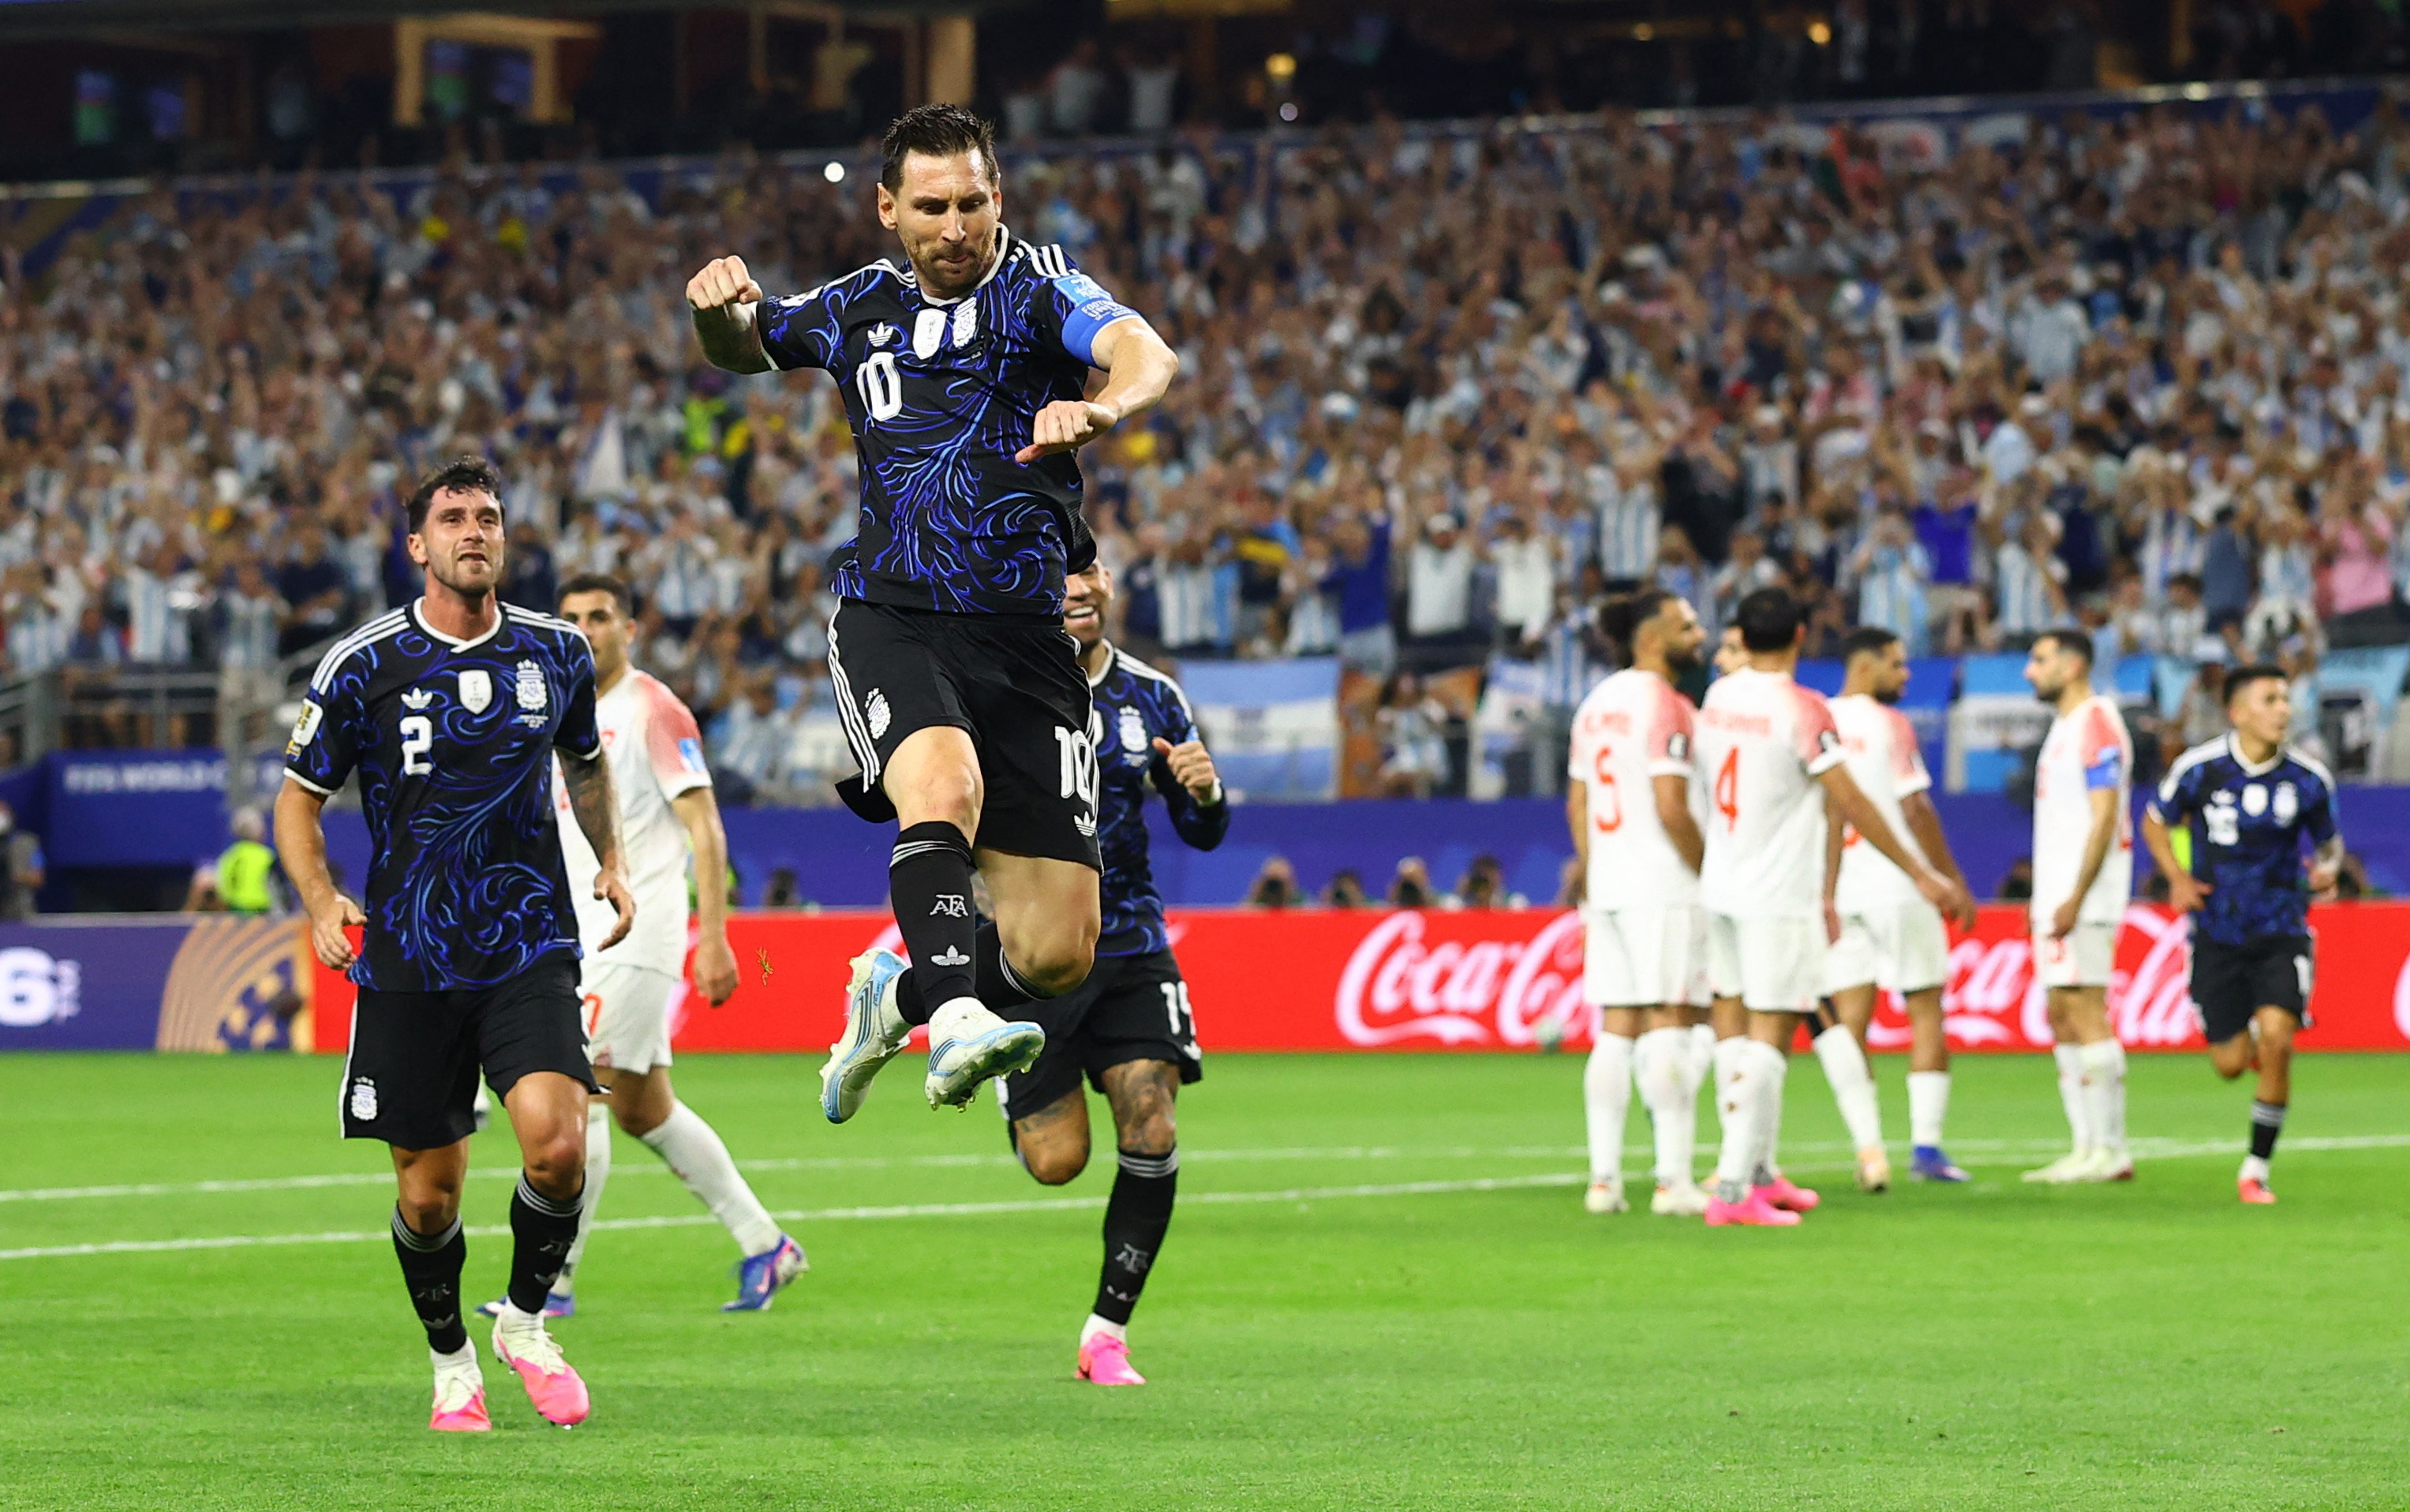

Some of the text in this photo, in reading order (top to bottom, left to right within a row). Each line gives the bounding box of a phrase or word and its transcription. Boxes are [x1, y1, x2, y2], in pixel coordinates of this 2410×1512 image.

[856, 352, 902, 428] 10
[400, 715, 433, 777] 2
[1054, 725, 1095, 805] 10
[1595, 747, 1622, 835] 5
[1715, 744, 1738, 836] 4
[929, 893, 970, 919] AFA
